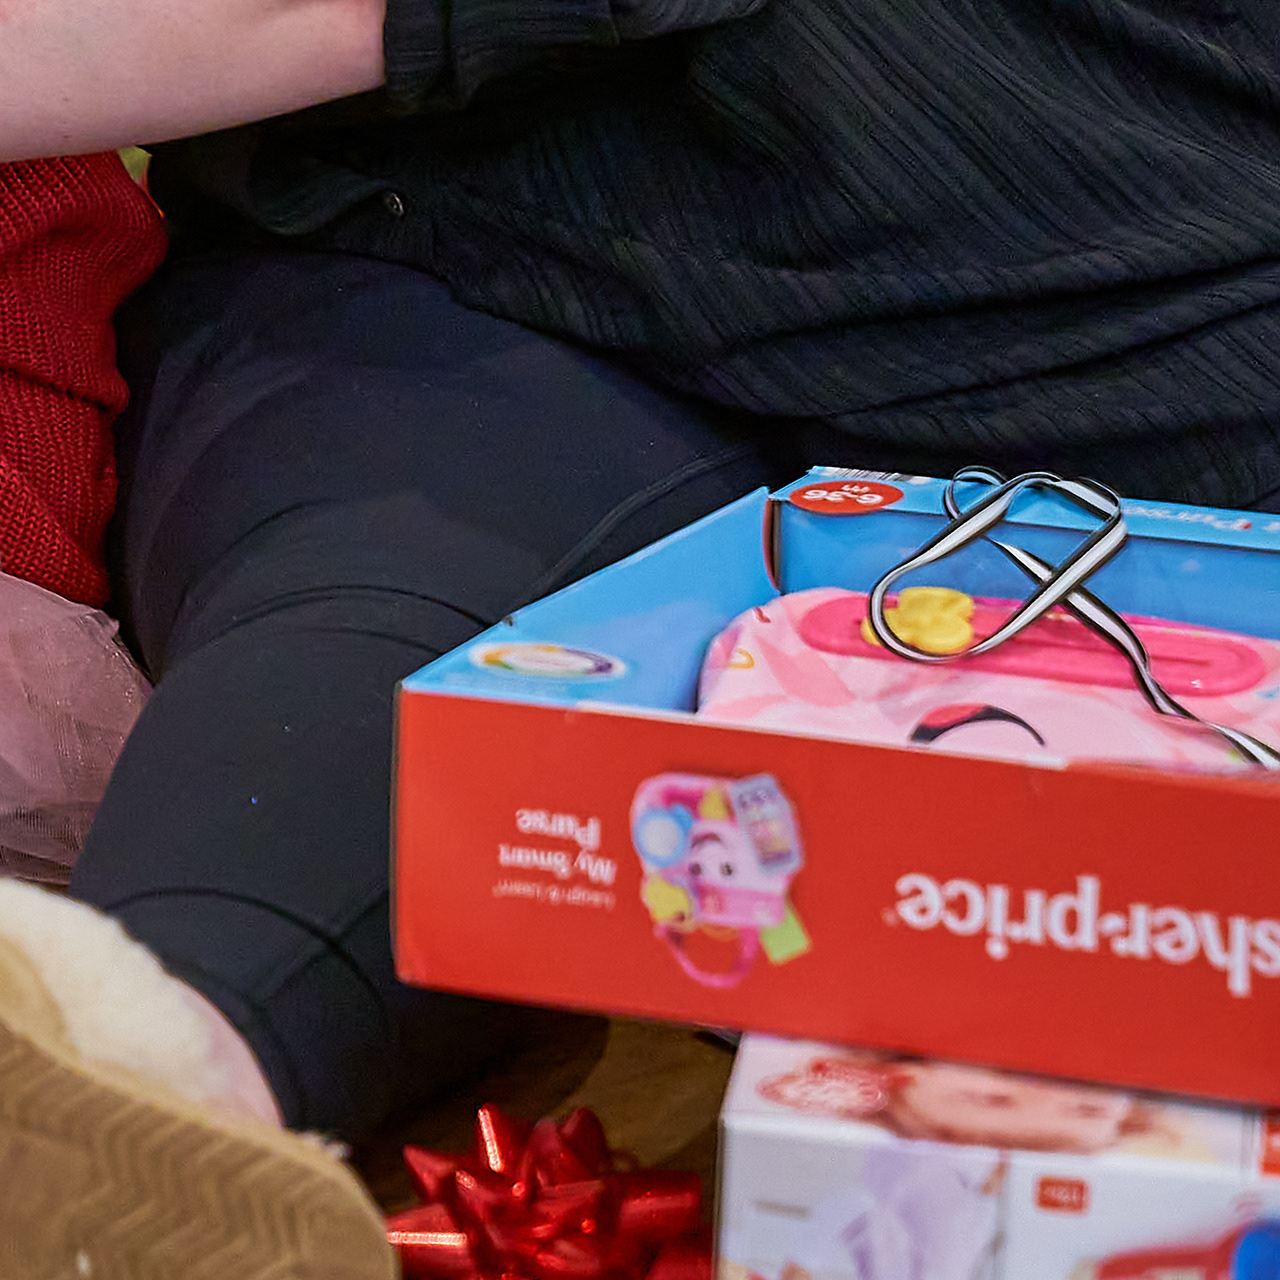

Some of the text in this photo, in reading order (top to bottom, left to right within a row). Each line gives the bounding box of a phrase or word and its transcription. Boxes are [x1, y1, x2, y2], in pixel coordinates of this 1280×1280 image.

[803, 490, 883, 505] 6-36
[516, 810, 600, 850] Purse
[498, 845, 616, 885] My Smart
